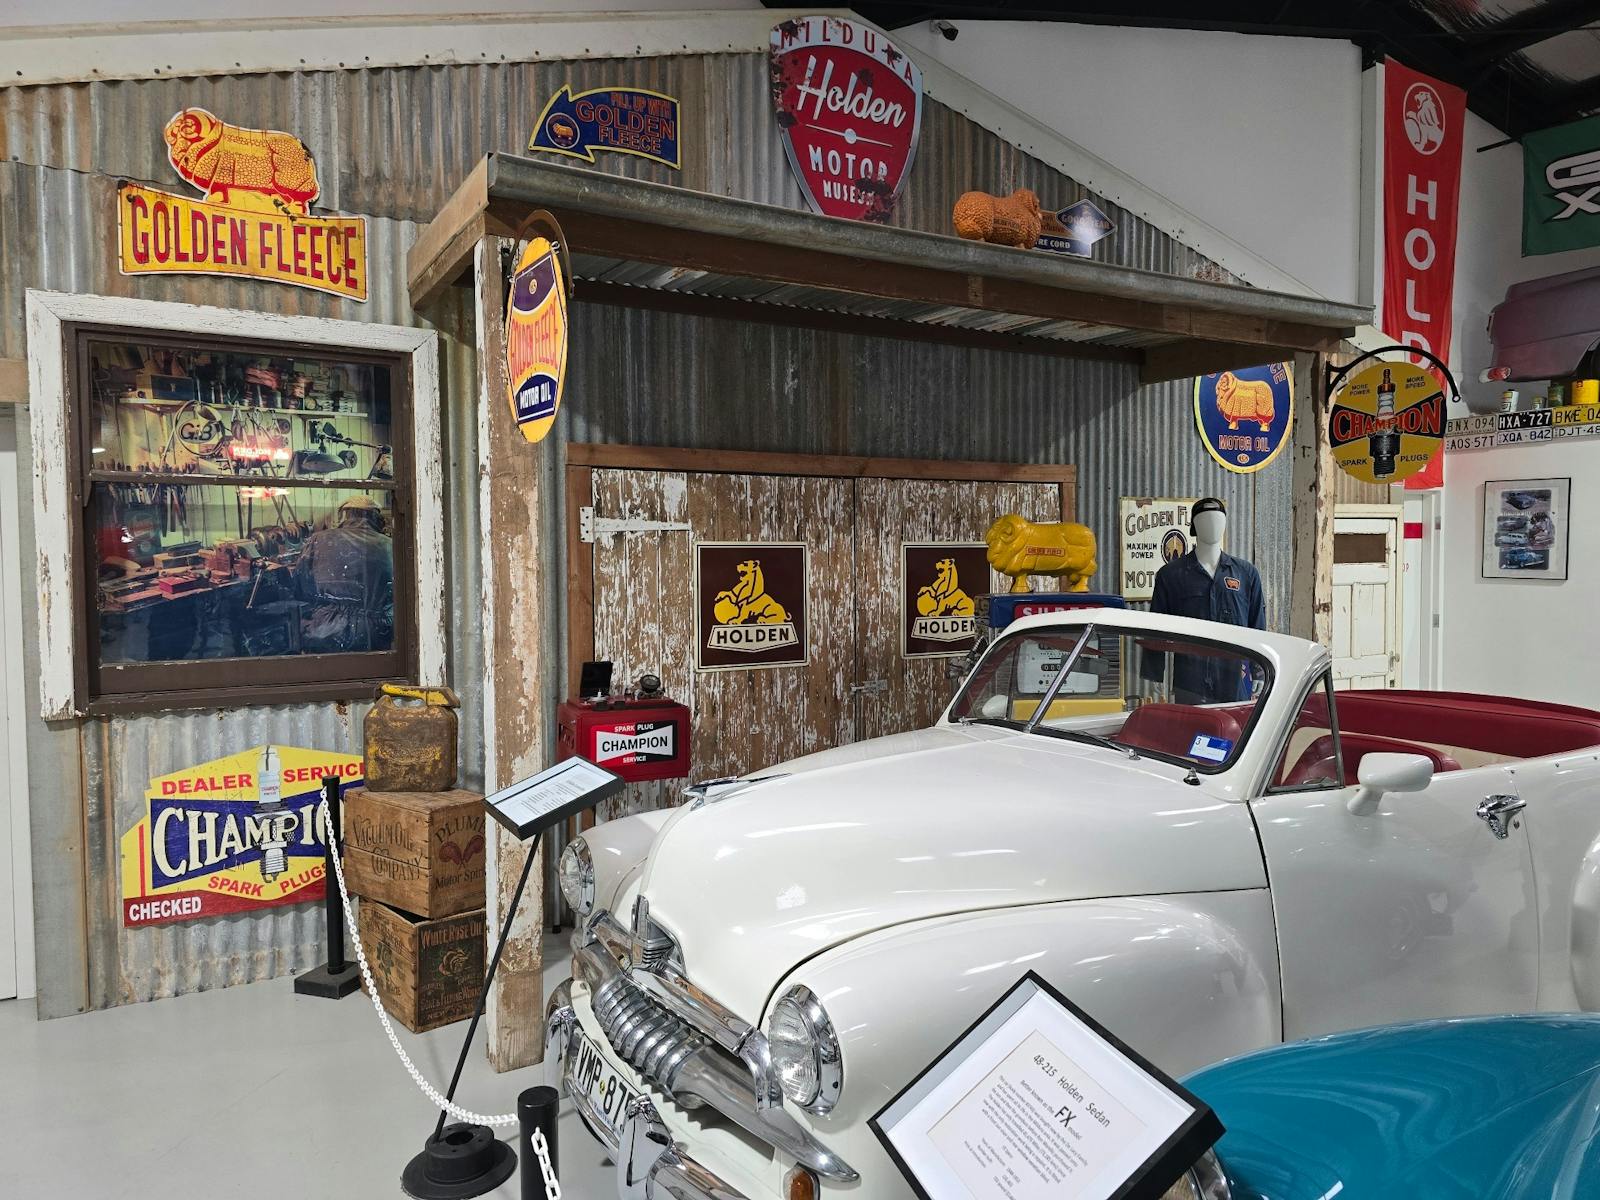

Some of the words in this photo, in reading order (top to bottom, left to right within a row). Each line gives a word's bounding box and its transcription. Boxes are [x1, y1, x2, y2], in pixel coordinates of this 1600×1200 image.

[781, 20, 914, 86] MILDURA
[796, 54, 906, 128] Holden
[575, 101, 675, 141] GOLDEN
[599, 125, 662, 154] FLEECE
[808, 144, 888, 182] MOTOR
[131, 195, 248, 265] GOLDEN
[259, 222, 358, 290] FLEECE
[1050, 240, 1071, 249] CORD
[1401, 174, 1438, 371] HOLD
[520, 386, 540, 410] MOTOR
[540, 381, 552, 404] OIL
[1333, 398, 1442, 442] CHAMPION
[1218, 434, 1252, 451] MOTOR
[1254, 437, 1271, 452] OIL
[1341, 457, 1368, 467] SPARK
[1400, 453, 1429, 463] PLUGS
[1125, 511, 1174, 536] GOLDEN
[1126, 543, 1158, 551] MAXIMUM
[1131, 551, 1154, 559] POWER
[1125, 570, 1155, 589] MOT
[716, 627, 790, 644] HOLDEN
[614, 725, 635, 733] SPARK
[637, 723, 654, 731] PLUG
[602, 736, 668, 752] CHAMPION
[623, 755, 647, 763] SERVICE
[161, 774, 253, 795] DEALER
[153, 800, 345, 878] CHAMPIO
[207, 876, 264, 897] SPARK
[128, 896, 202, 922] CHECKED
[1033, 1054, 1058, 1077] 48-215
[1057, 1076, 1084, 1103] Holden
[1085, 1102, 1111, 1128] Sedan
[1054, 1105, 1077, 1128] FX
